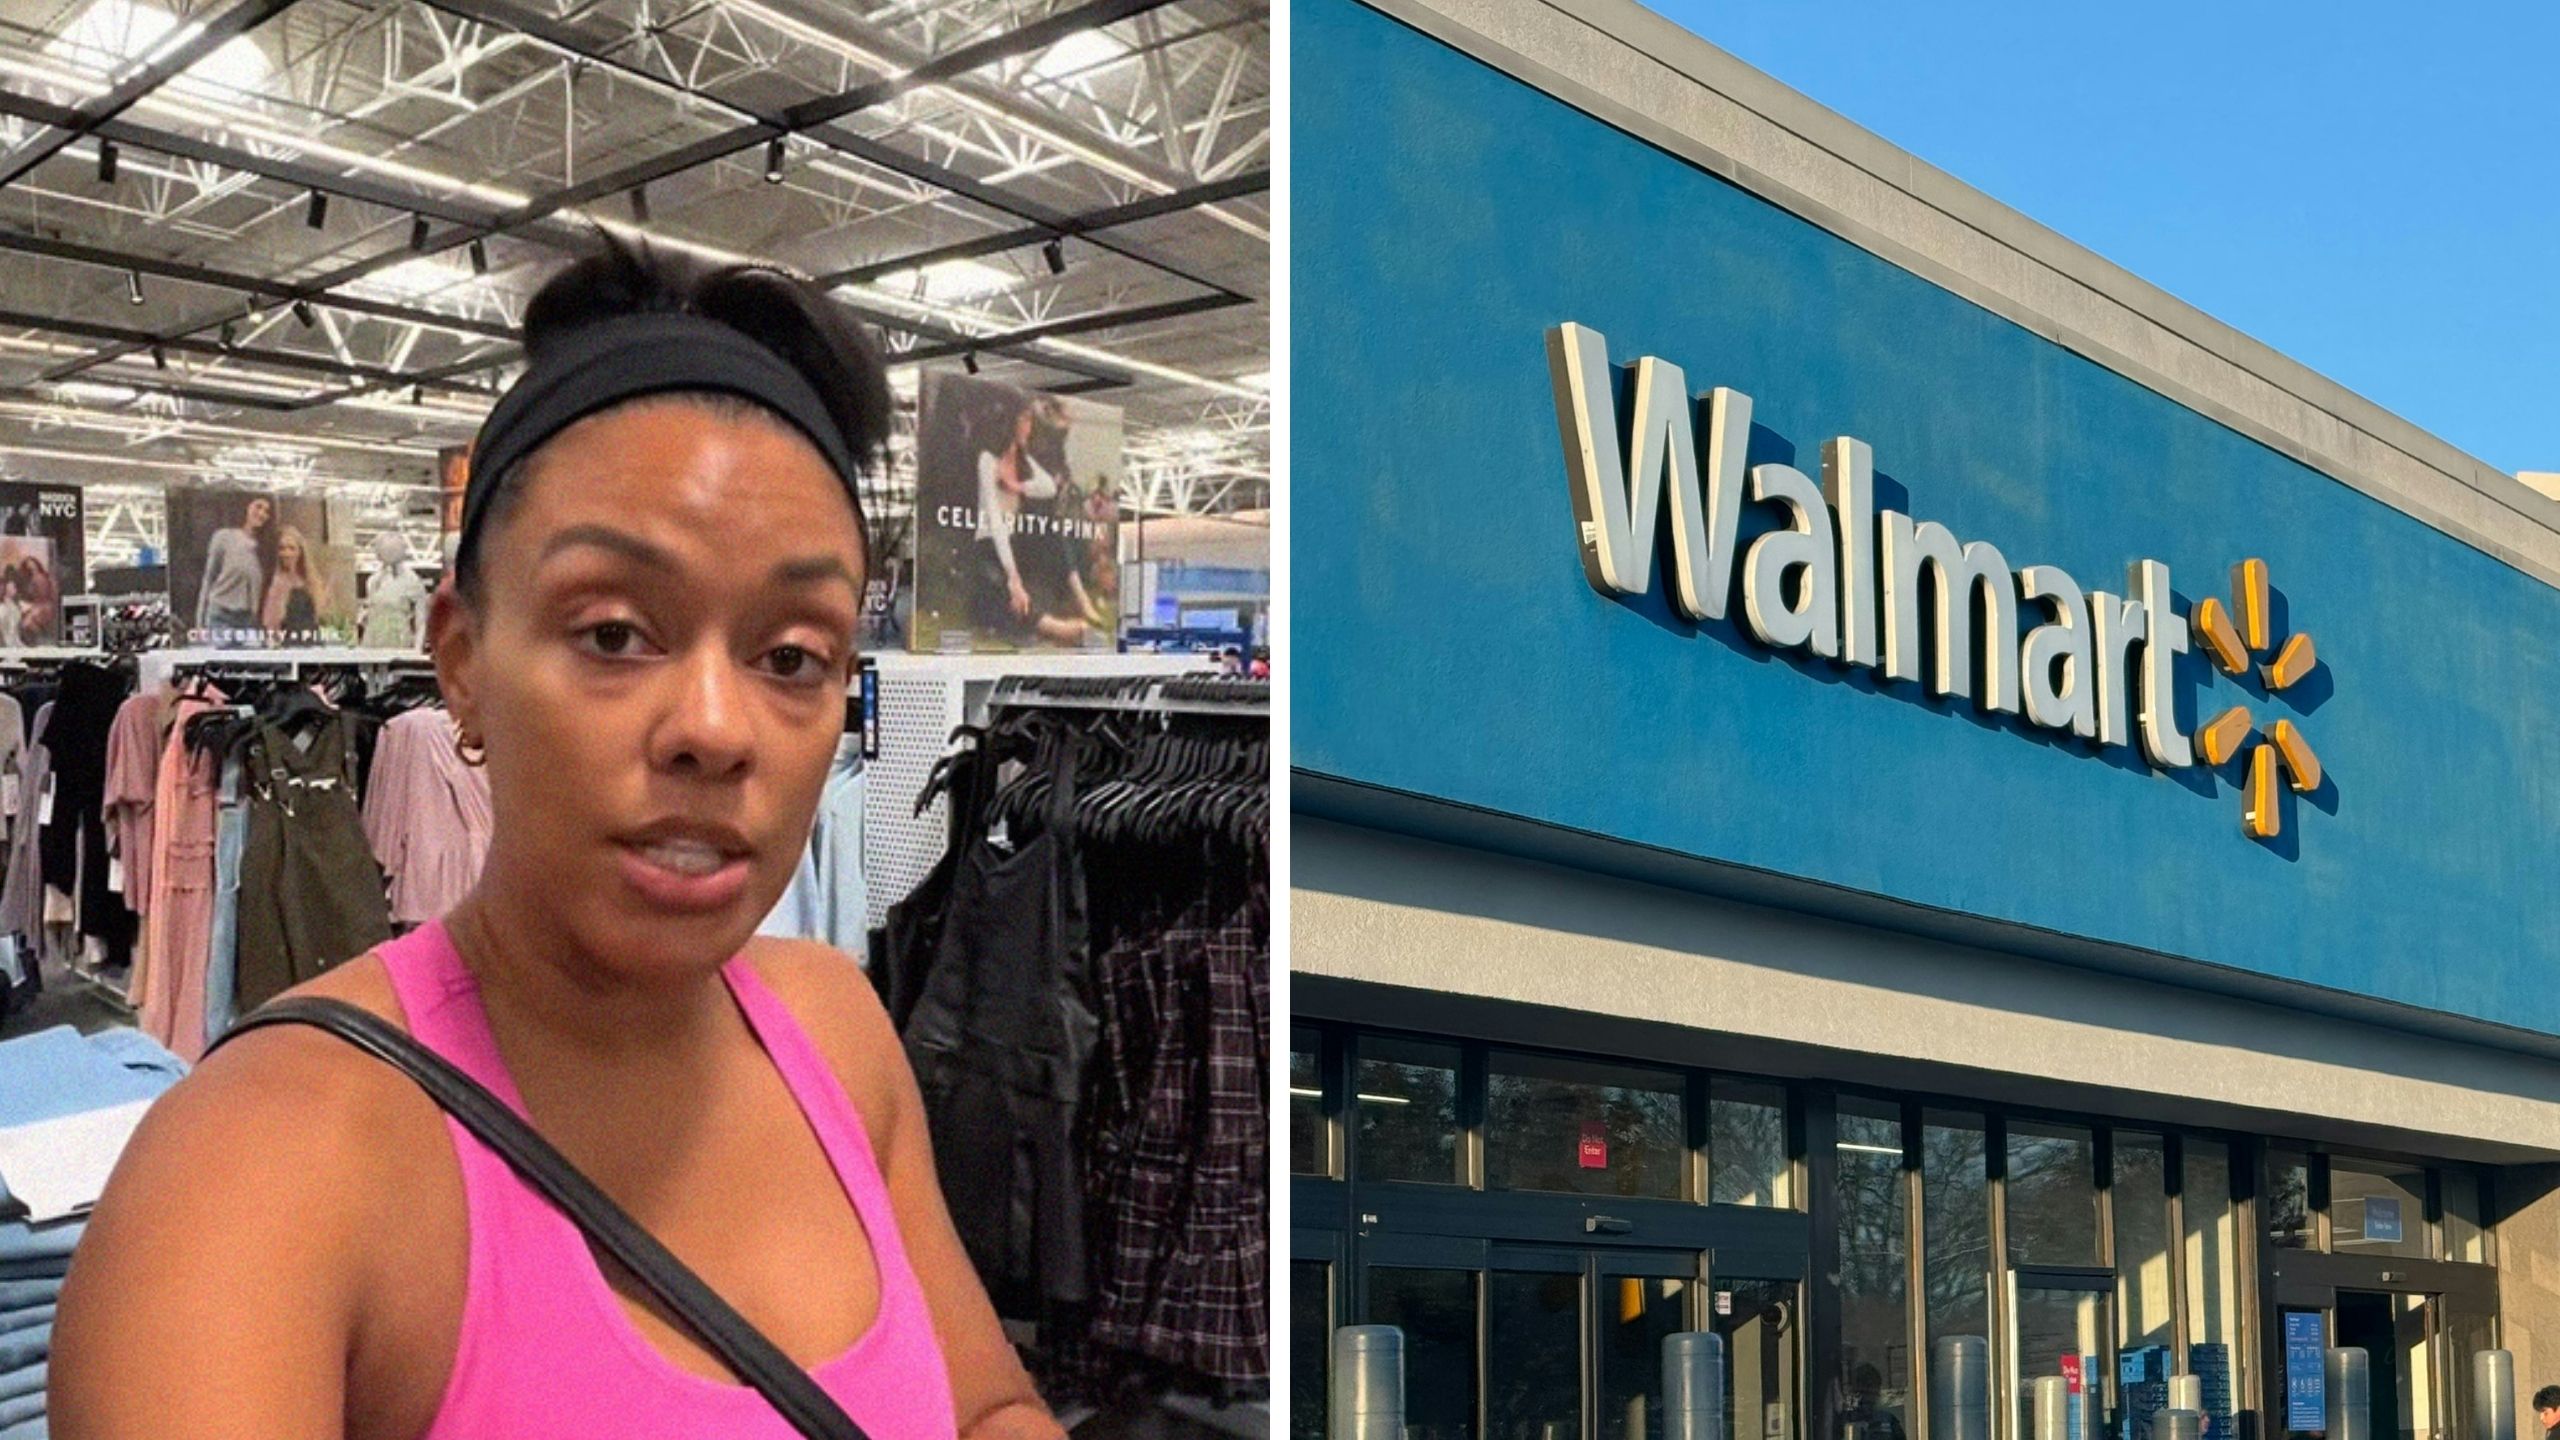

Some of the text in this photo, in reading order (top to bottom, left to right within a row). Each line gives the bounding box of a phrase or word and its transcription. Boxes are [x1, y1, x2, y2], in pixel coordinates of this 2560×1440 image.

[39, 502, 77, 519] NYC
[937, 505, 1048, 536] CELRITY
[1546, 322, 2193, 768] Walmart
